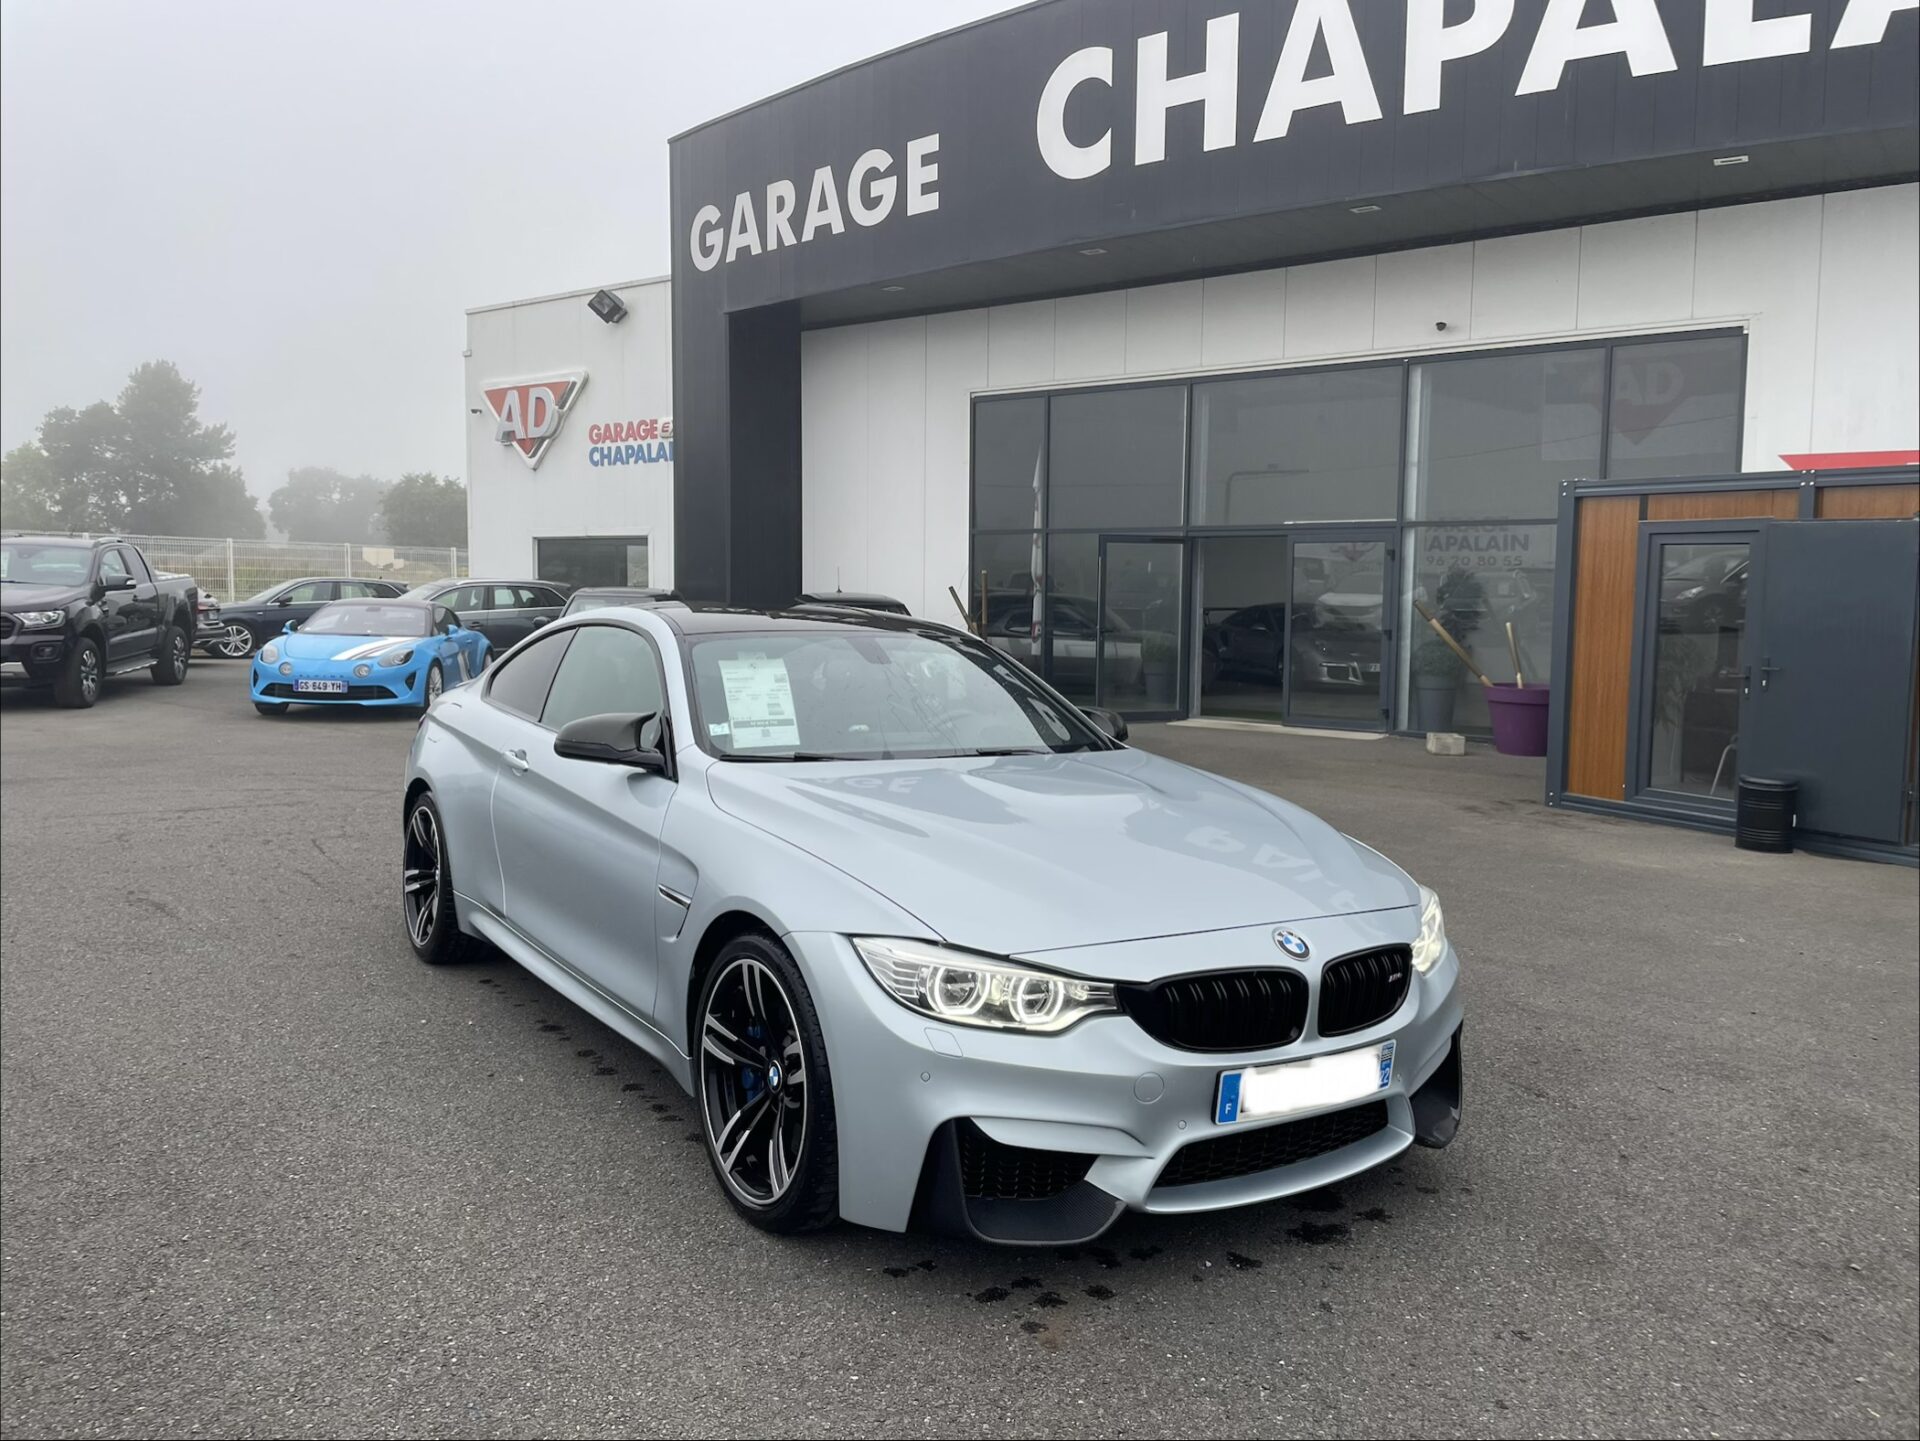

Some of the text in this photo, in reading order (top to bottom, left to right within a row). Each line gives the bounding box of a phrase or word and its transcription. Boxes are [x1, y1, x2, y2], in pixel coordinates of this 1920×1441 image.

[690, 133, 940, 272] GARAGE
[495, 386, 558, 442] AD
[588, 419, 658, 445] GARAGE
[1225, 1103, 1232, 1115] F
